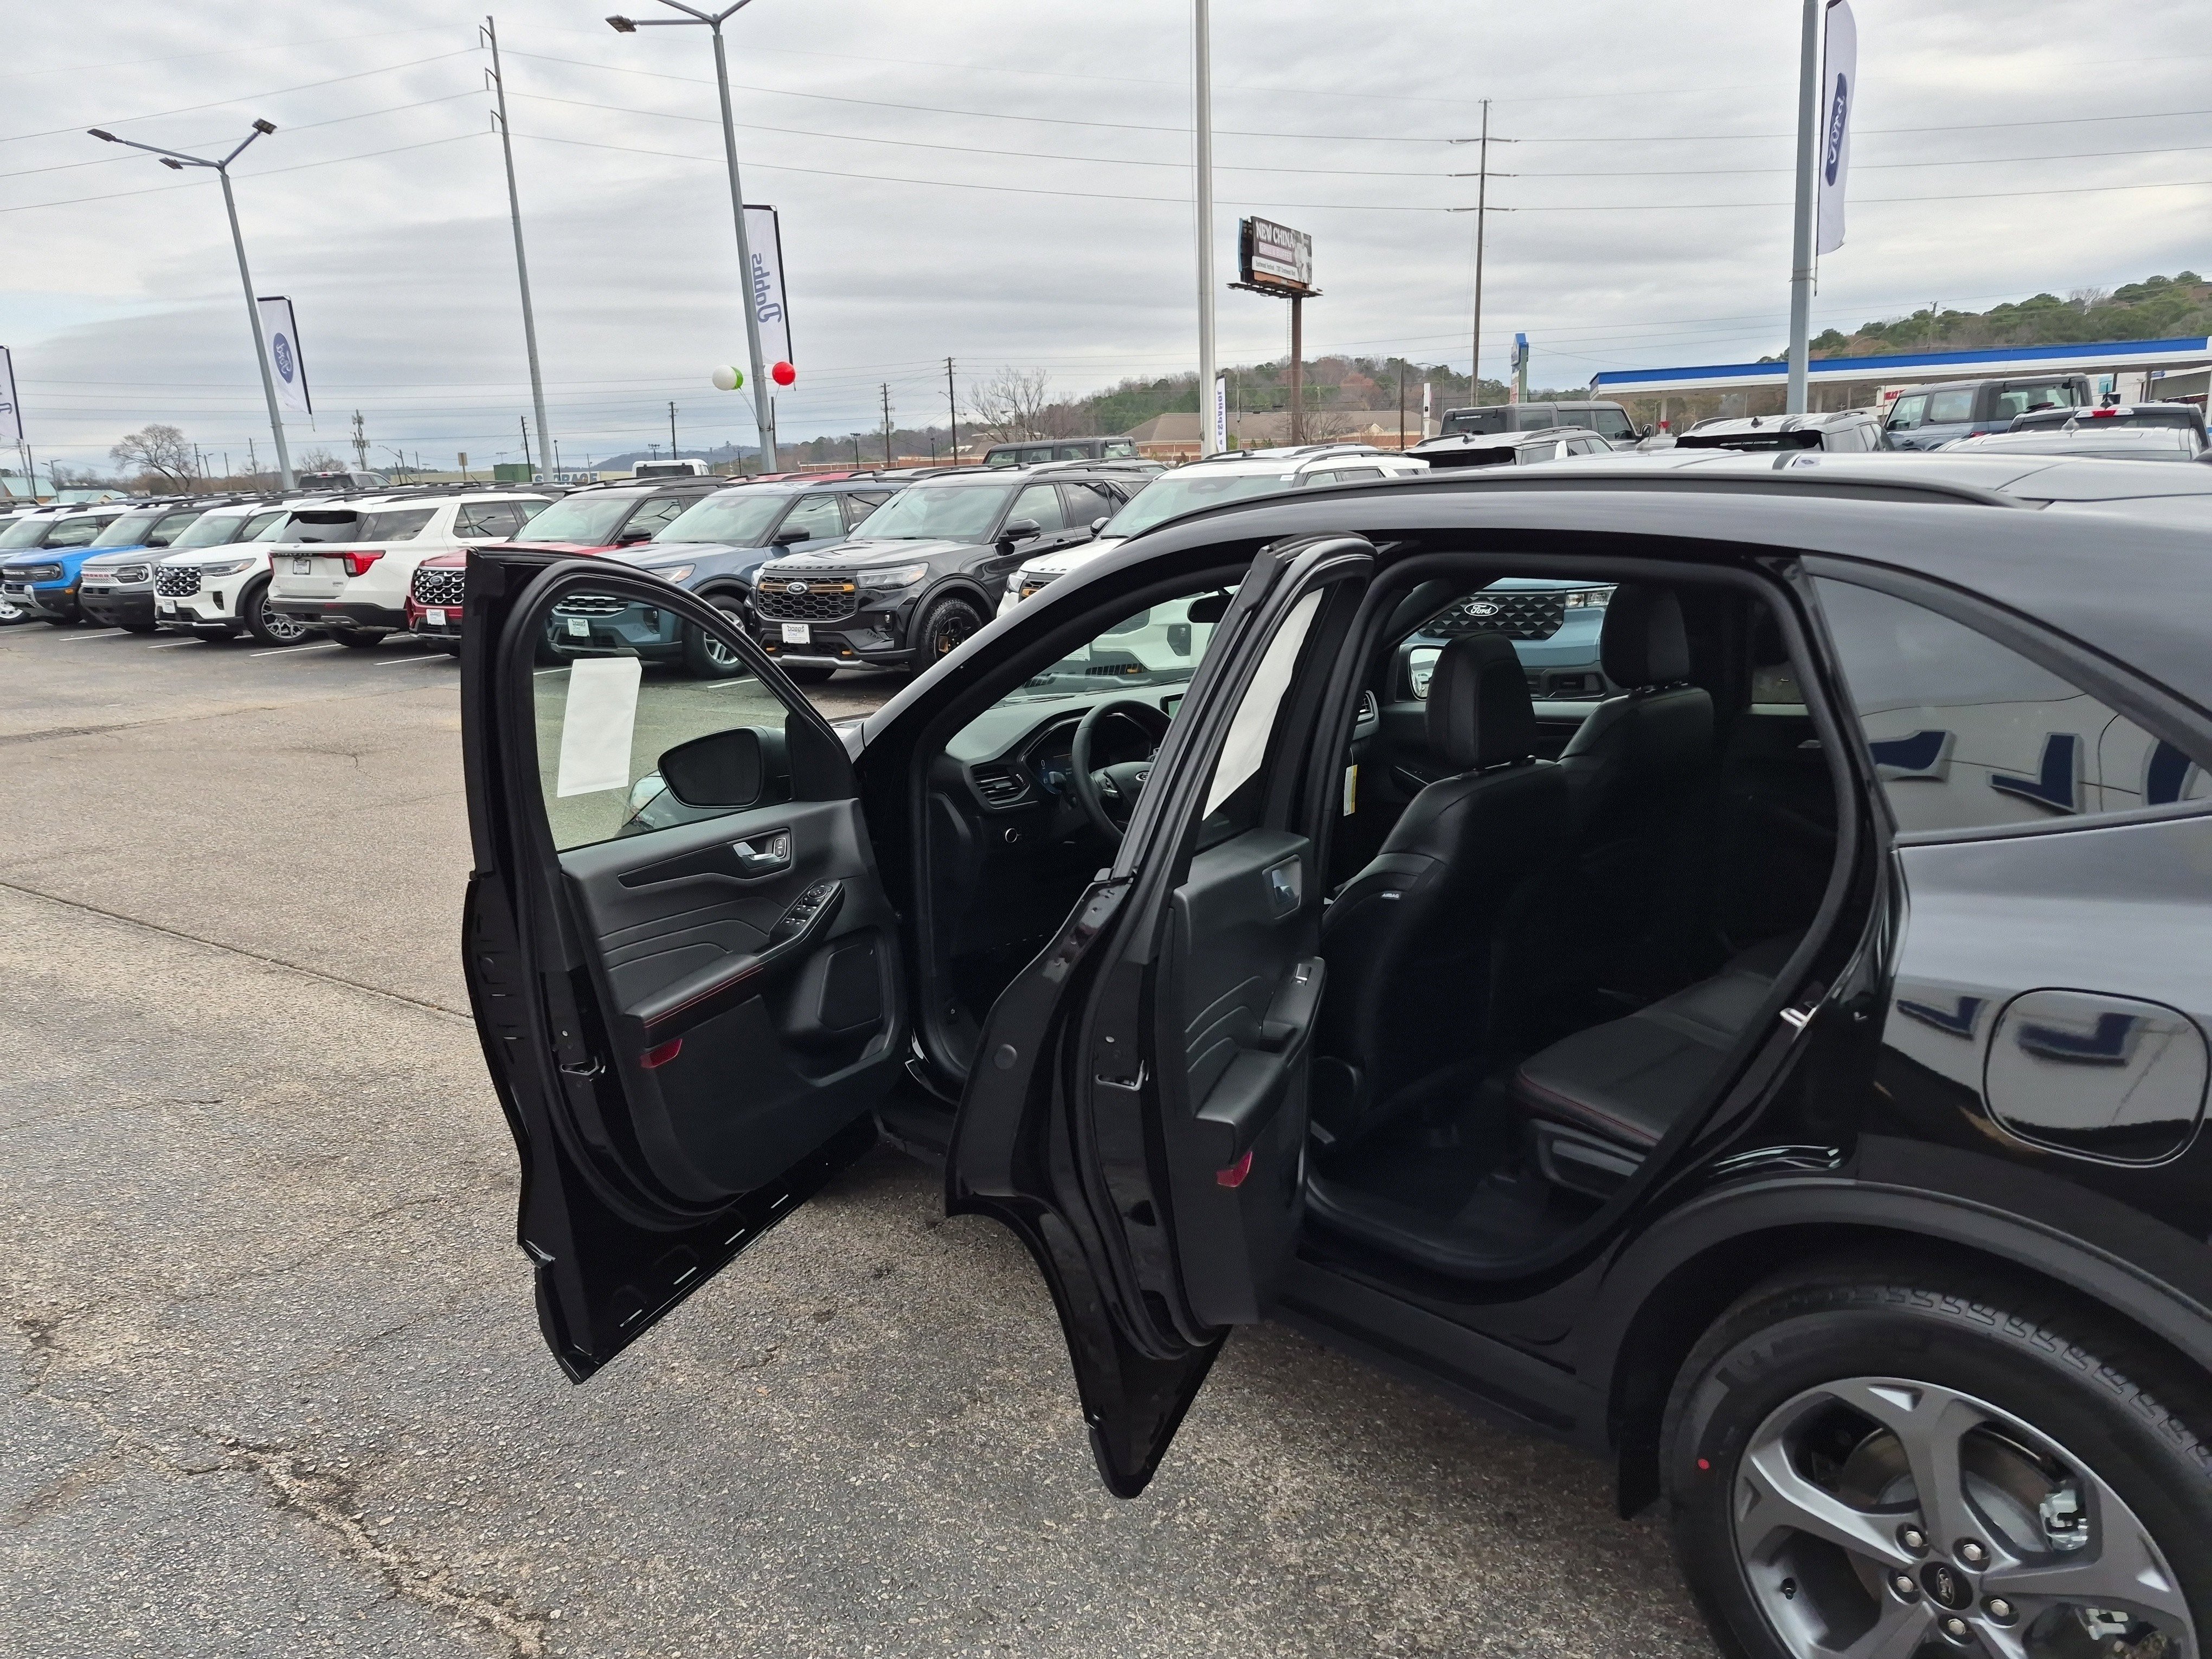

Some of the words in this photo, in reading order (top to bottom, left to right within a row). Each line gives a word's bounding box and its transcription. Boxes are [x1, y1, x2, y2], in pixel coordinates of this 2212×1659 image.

[1828, 96, 1845, 164] Ford
[1256, 221, 1272, 242] NEW
[1273, 227, 1295, 249] CHINA
[535, 473, 597, 485] SORAGE
[1470, 605, 1492, 614] Ford
